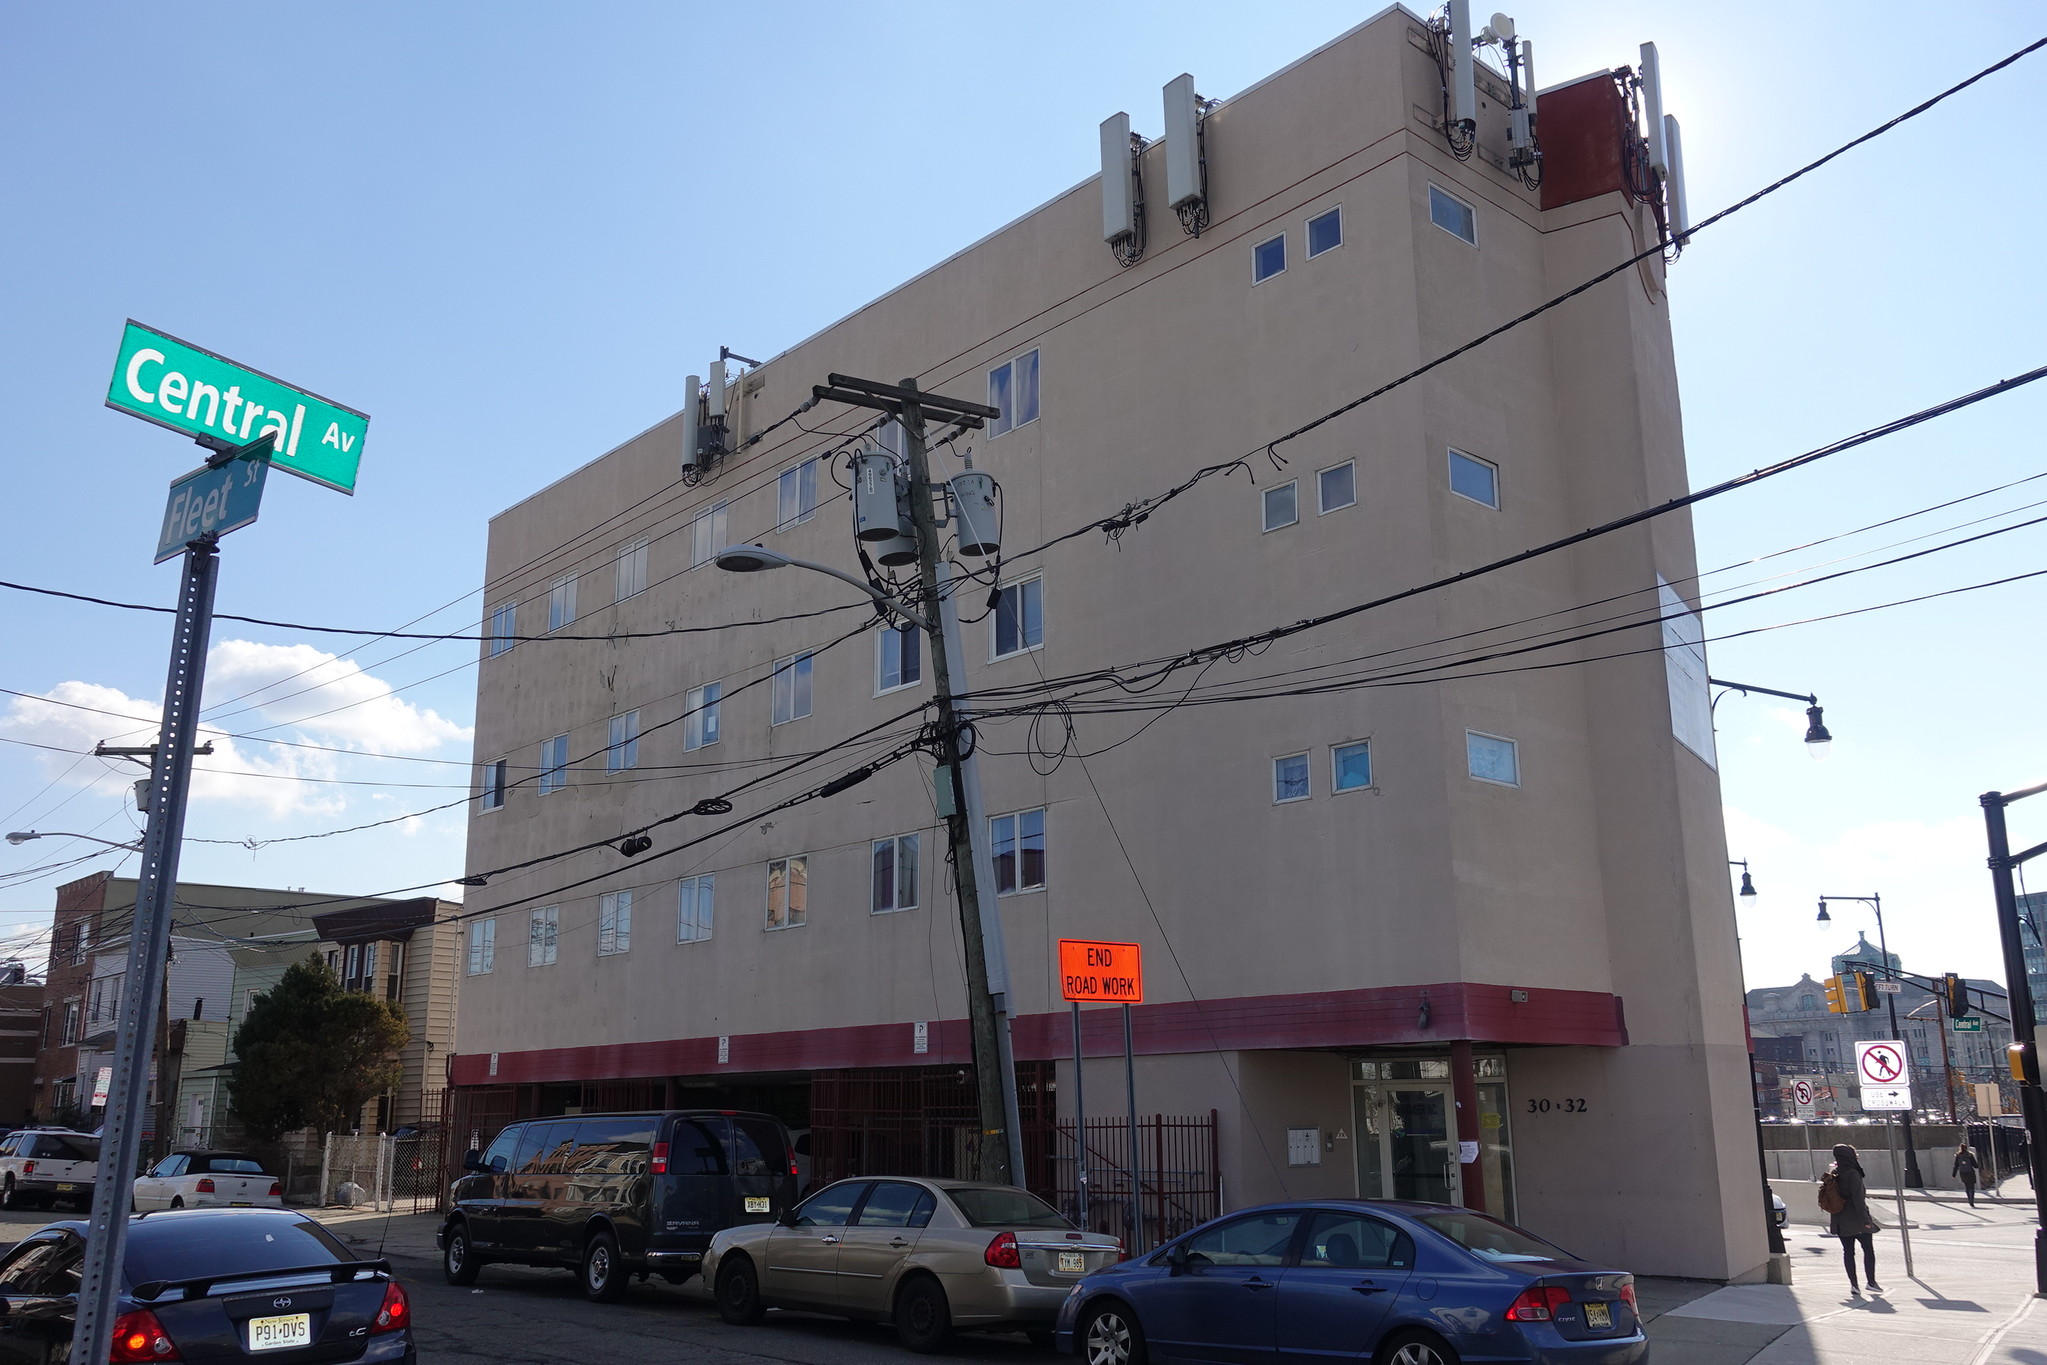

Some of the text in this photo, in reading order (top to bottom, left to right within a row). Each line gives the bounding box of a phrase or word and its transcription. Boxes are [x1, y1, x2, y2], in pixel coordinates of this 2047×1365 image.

[125, 347, 355, 457] Central Av
[164, 458, 261, 545] Fleet St
[1087, 948, 1112, 967] END
[1066, 975, 1135, 996] ROAD WORK
